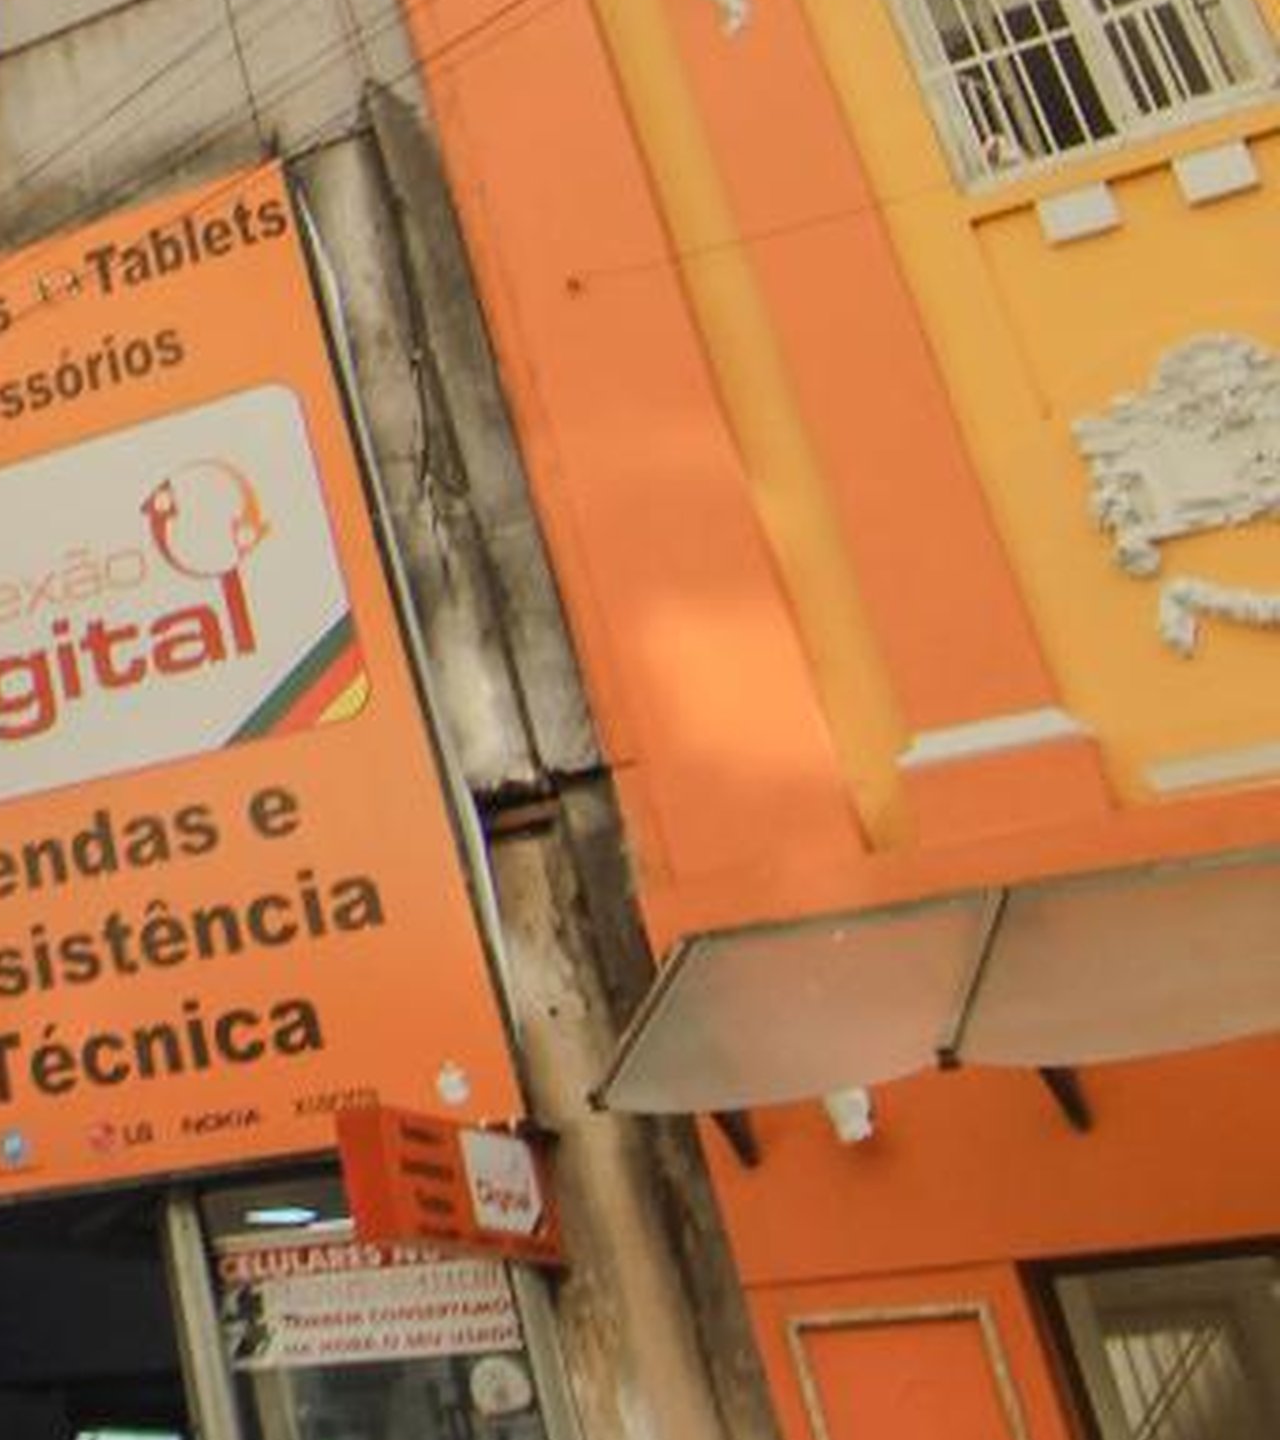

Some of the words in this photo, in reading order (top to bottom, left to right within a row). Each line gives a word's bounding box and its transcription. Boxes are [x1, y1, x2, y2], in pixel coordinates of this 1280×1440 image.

[84, 194, 288, 298] Tablets
[248, 786, 299, 839] e
[179, 1108, 260, 1134] NOKIA
